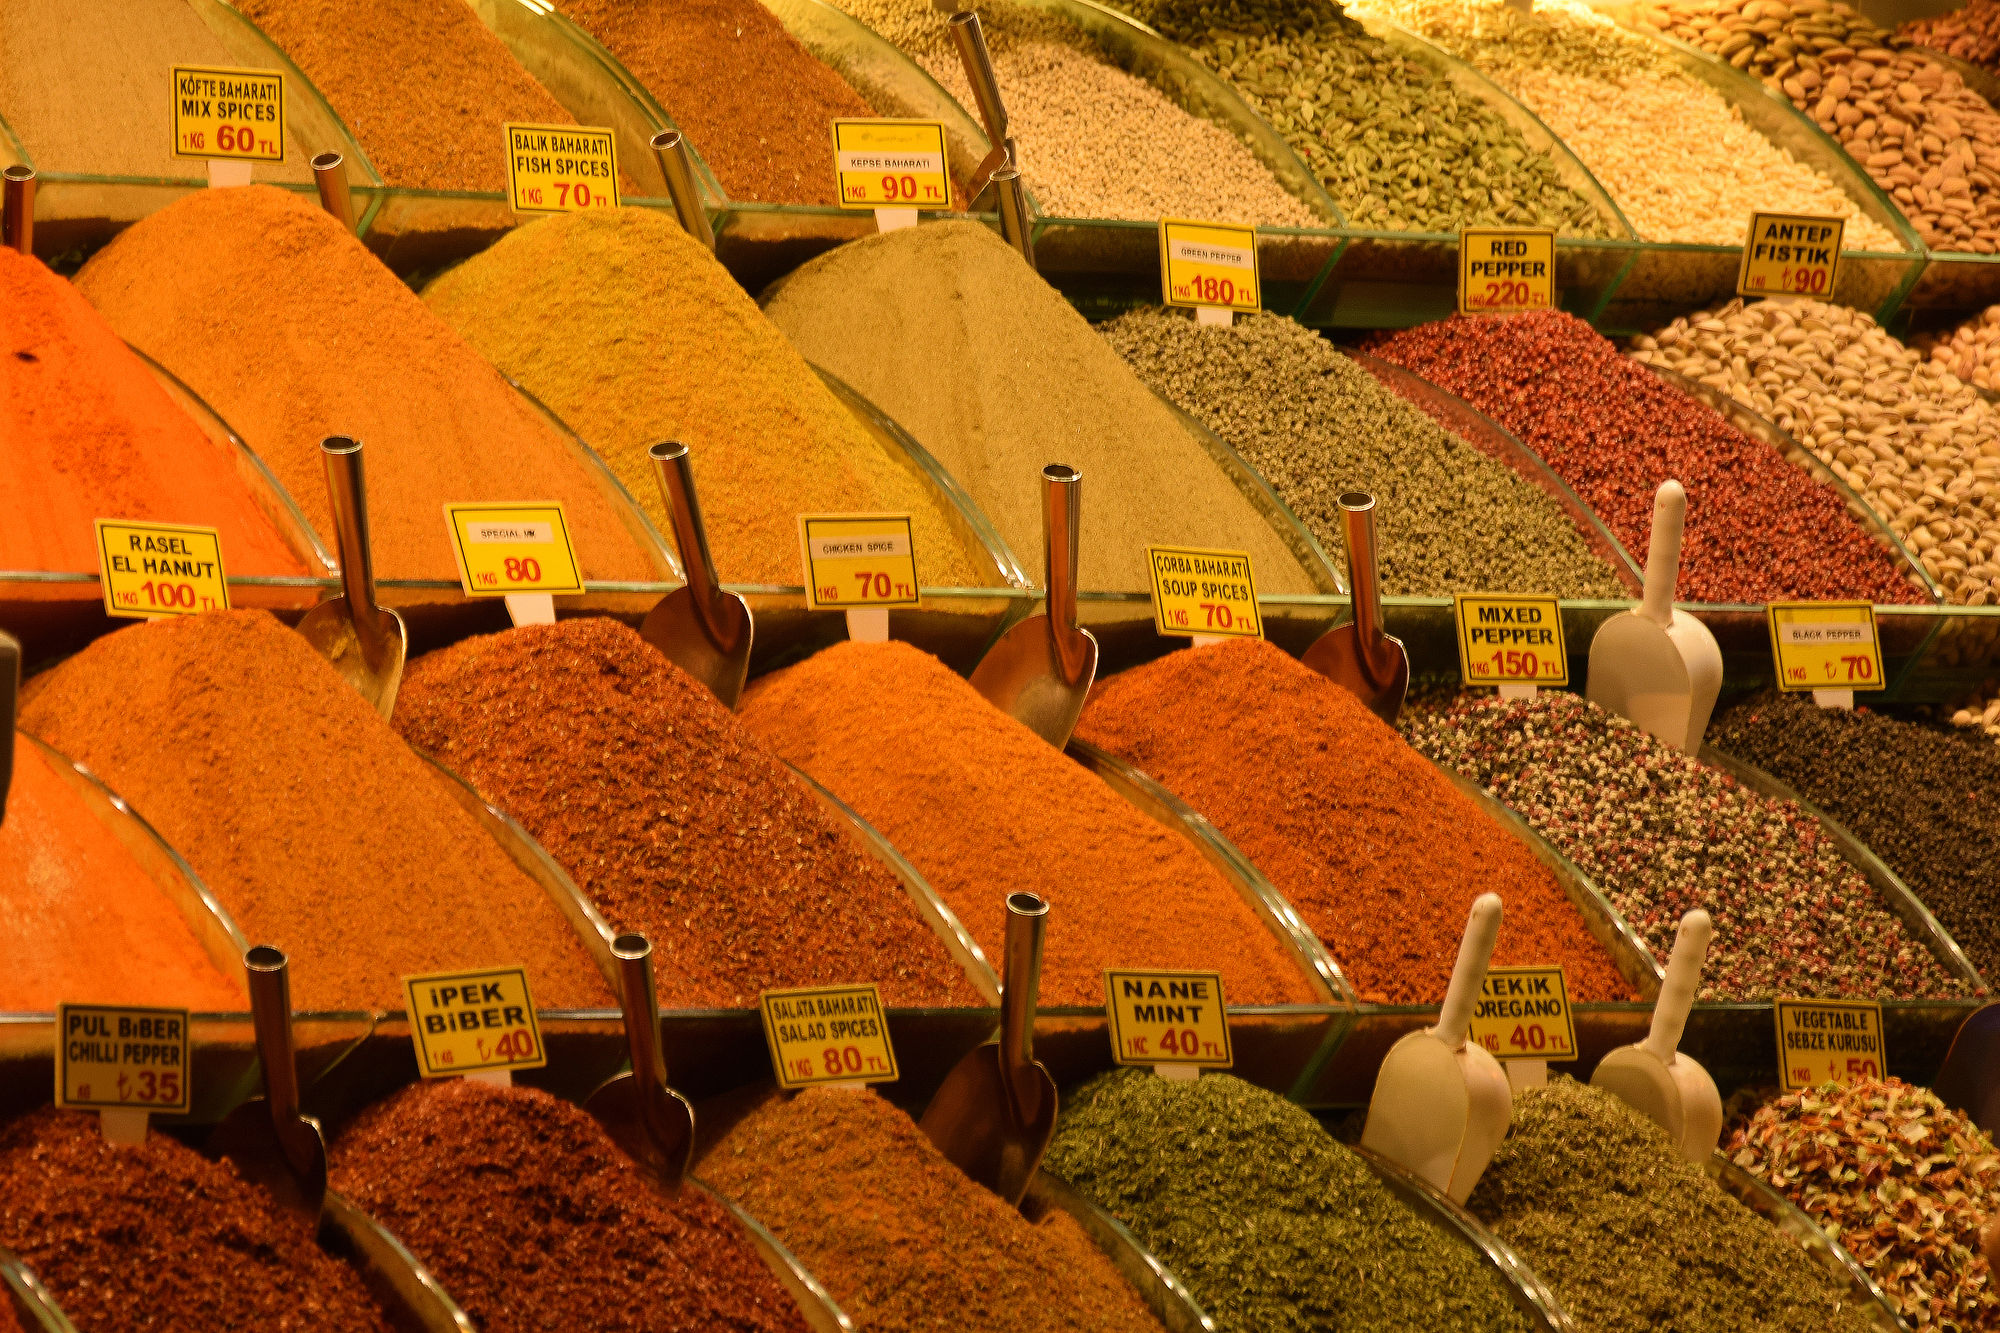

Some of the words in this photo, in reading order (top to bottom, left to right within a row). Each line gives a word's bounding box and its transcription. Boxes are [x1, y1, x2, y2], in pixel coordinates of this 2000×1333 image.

[219, 81, 277, 102] BAHARATI
[182, 100, 211, 117] MIX
[217, 102, 275, 122] SPICES
[216, 124, 255, 152] 60
[258, 140, 277, 154] TL
[515, 134, 548, 151] BALIK
[552, 137, 608, 156] BAHARATI
[517, 157, 551, 174] FISH
[556, 159, 609, 177] SPICES
[850, 159, 881, 168] KEPSE
[884, 160, 930, 169] BAHARATI
[553, 182, 591, 208] 70
[881, 175, 917, 200] 90
[924, 186, 942, 199] TL
[1765, 223, 1832, 242] ANTEP
[1181, 247, 1208, 258] GREEN
[1210, 251, 1242, 264] PEPPER
[1491, 241, 1527, 256] RED
[1755, 244, 1829, 264] FISTIK
[1471, 262, 1545, 277] PEPPER
[1192, 275, 1234, 305] 180
[1239, 289, 1253, 302] TL
[1485, 281, 1529, 307] 220
[1532, 292, 1547, 306] TL
[129, 535, 192, 555] RASEL
[822, 544, 862, 555] CHICKEN
[867, 541, 894, 552] SPICE
[112, 556, 137, 572] EL
[143, 558, 214, 578] HANUT
[504, 557, 541, 582] 80
[1156, 556, 1192, 576] ÇORBA
[1194, 559, 1247, 579] BAHARATI
[141, 580, 195, 608] 100
[855, 572, 892, 598] 70
[895, 584, 914, 597] TL
[1163, 579, 1197, 596] SOUP
[1202, 582, 1248, 601] SPICES
[1200, 604, 1233, 629] 70
[1236, 617, 1255, 631] TL
[1478, 607, 1542, 623] MIXED
[1471, 628, 1553, 645] PEPPER
[1792, 630, 1822, 640] BLACK
[1827, 630, 1861, 640] PEPPER
[1491, 651, 1538, 677] 150
[1542, 662, 1560, 674] TL
[1123, 980, 1208, 999] NANE
[774, 1001, 816, 1020] SALATA
[817, 997, 875, 1016] BAHARATI
[1134, 1004, 1203, 1023] MINT
[1475, 999, 1561, 1017] OREGANO
[70, 1016, 111, 1037] PUL
[780, 1022, 826, 1043] SALAD
[831, 1019, 878, 1039] SPICES
[1794, 1010, 1867, 1030] VEGETABLE
[1160, 1028, 1199, 1056] 40
[1203, 1041, 1223, 1056] TL
[1510, 1024, 1546, 1050] 40
[1548, 1035, 1569, 1049] TL
[1788, 1031, 1824, 1049] SEBZE
[1828, 1033, 1876, 1052] KURUSU
[70, 1042, 118, 1063] CHILLI
[124, 1044, 179, 1066] PEPPER
[823, 1046, 862, 1074] 80
[865, 1057, 888, 1071] TL
